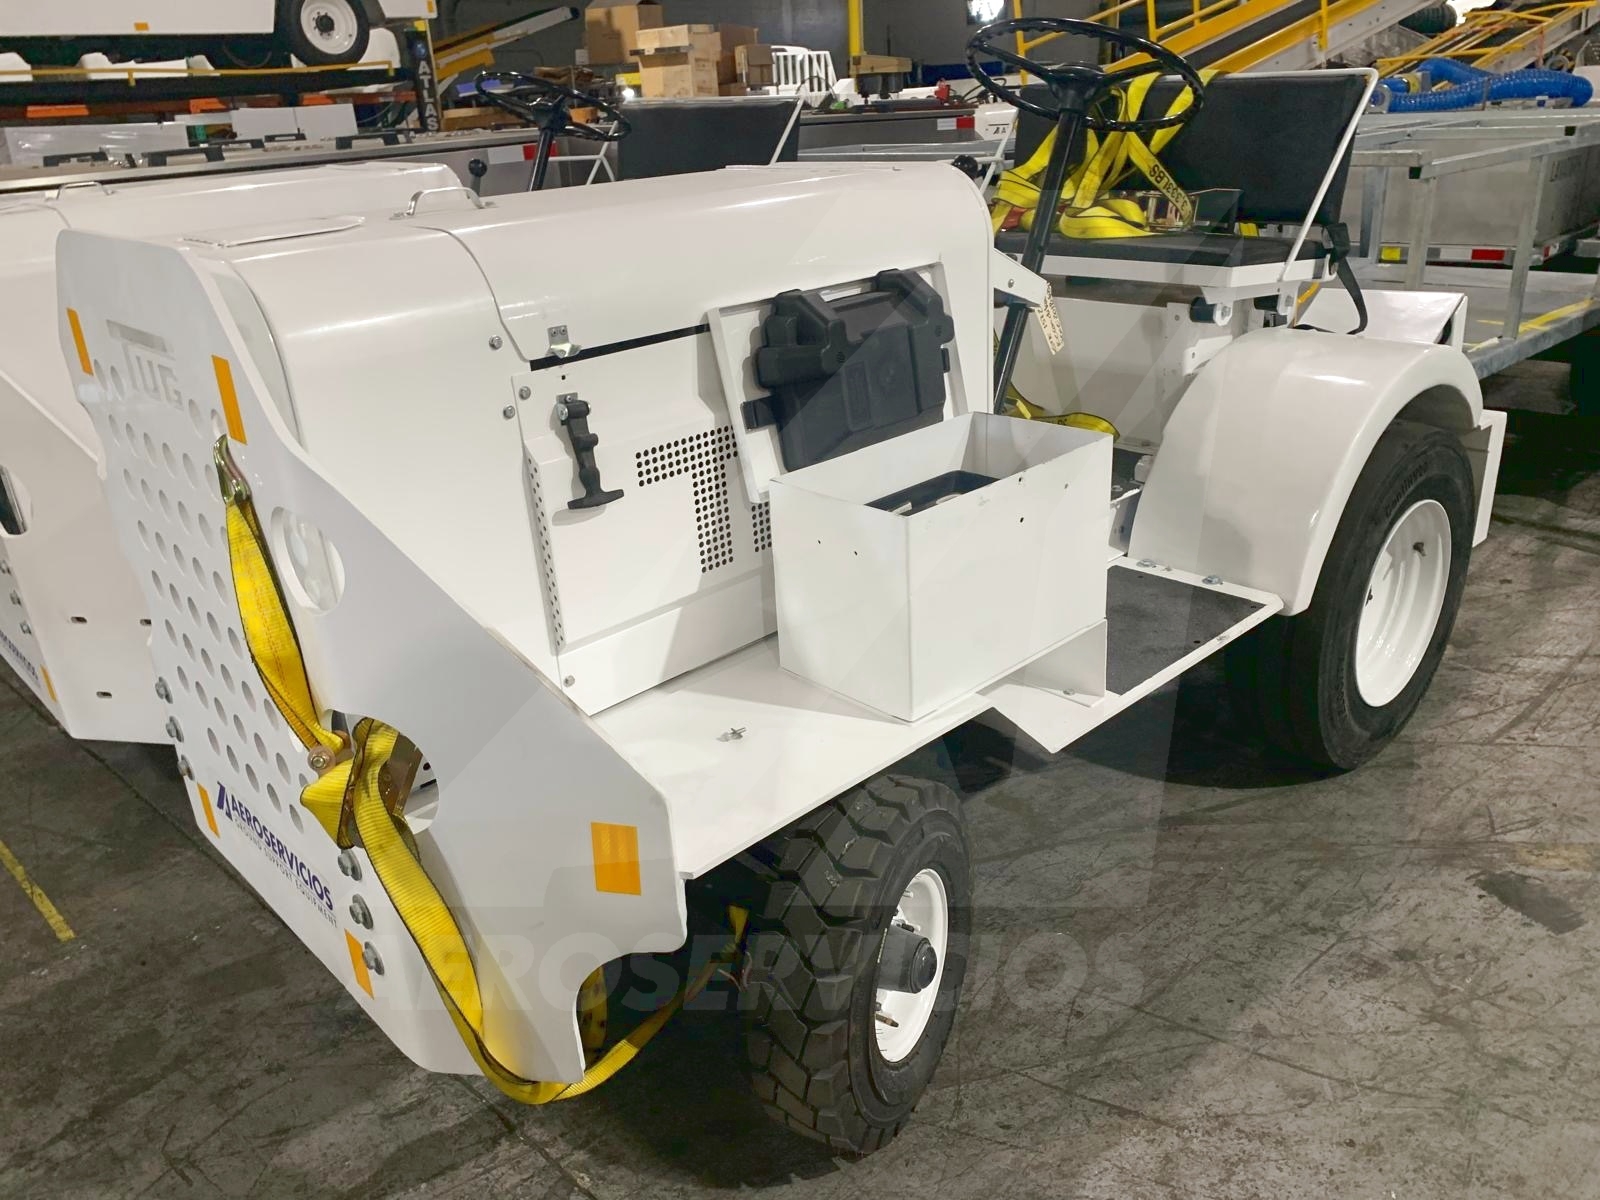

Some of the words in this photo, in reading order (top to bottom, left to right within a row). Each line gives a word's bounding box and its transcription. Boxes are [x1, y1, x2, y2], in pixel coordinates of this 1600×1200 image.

[418, 60, 439, 131] ATLAS
[105, 319, 185, 412] TUG
[231, 794, 334, 911] AEROSERVICIOS
